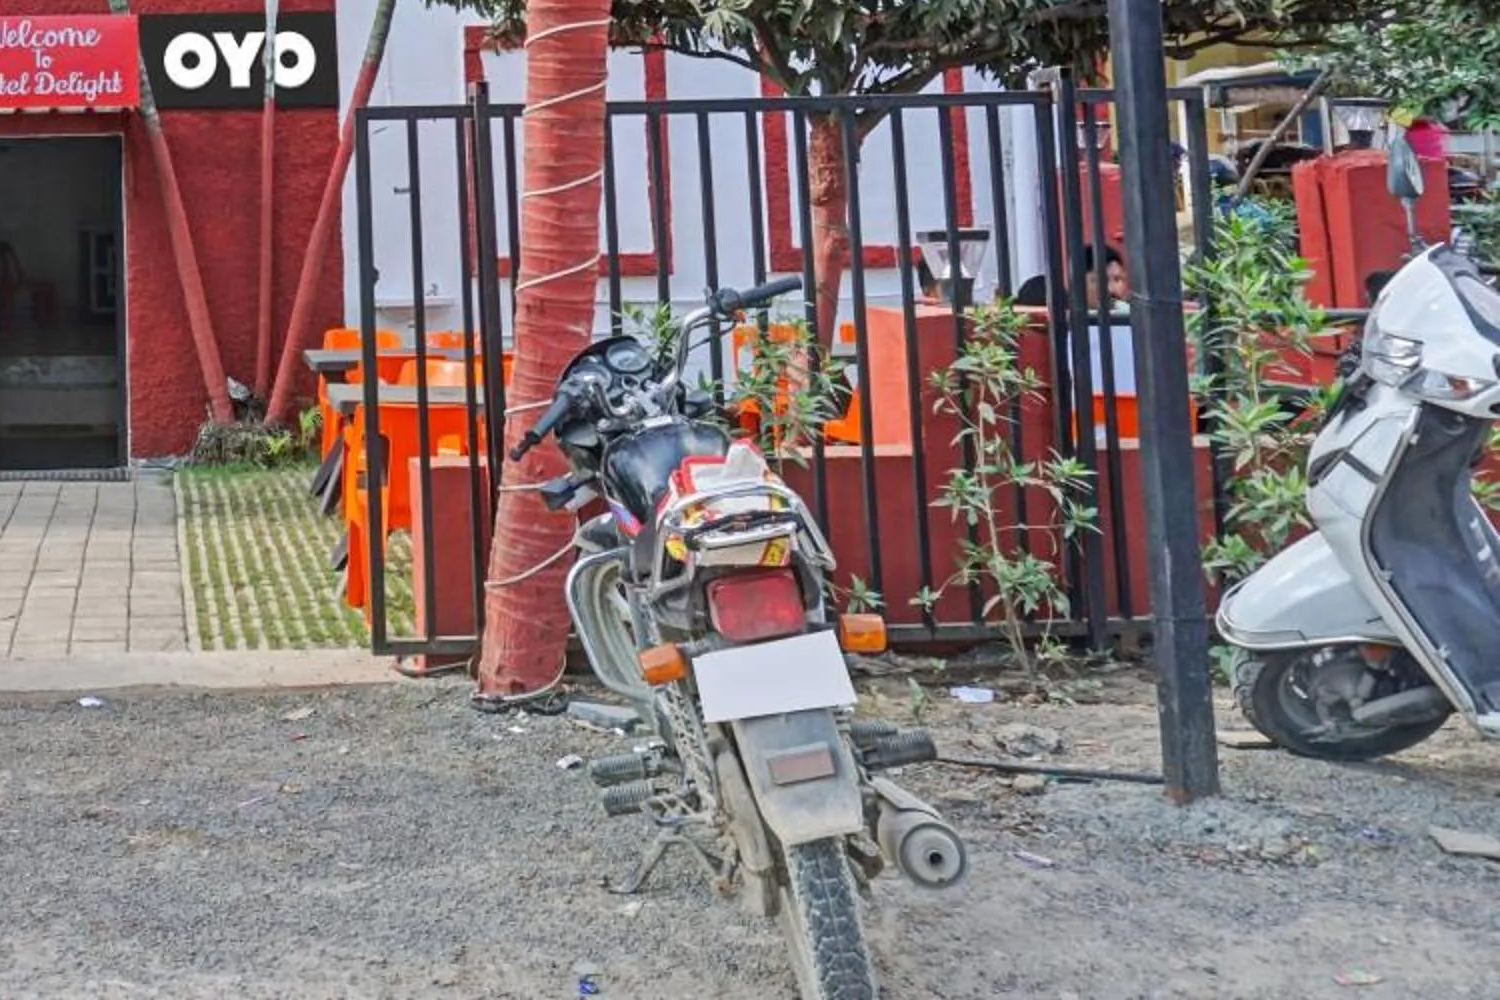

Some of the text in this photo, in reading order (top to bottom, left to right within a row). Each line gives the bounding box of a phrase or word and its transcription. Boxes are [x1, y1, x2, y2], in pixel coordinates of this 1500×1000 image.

[32, 48, 53, 69] To
[163, 31, 316, 89] OYO
[34, 71, 124, 102] Delight
